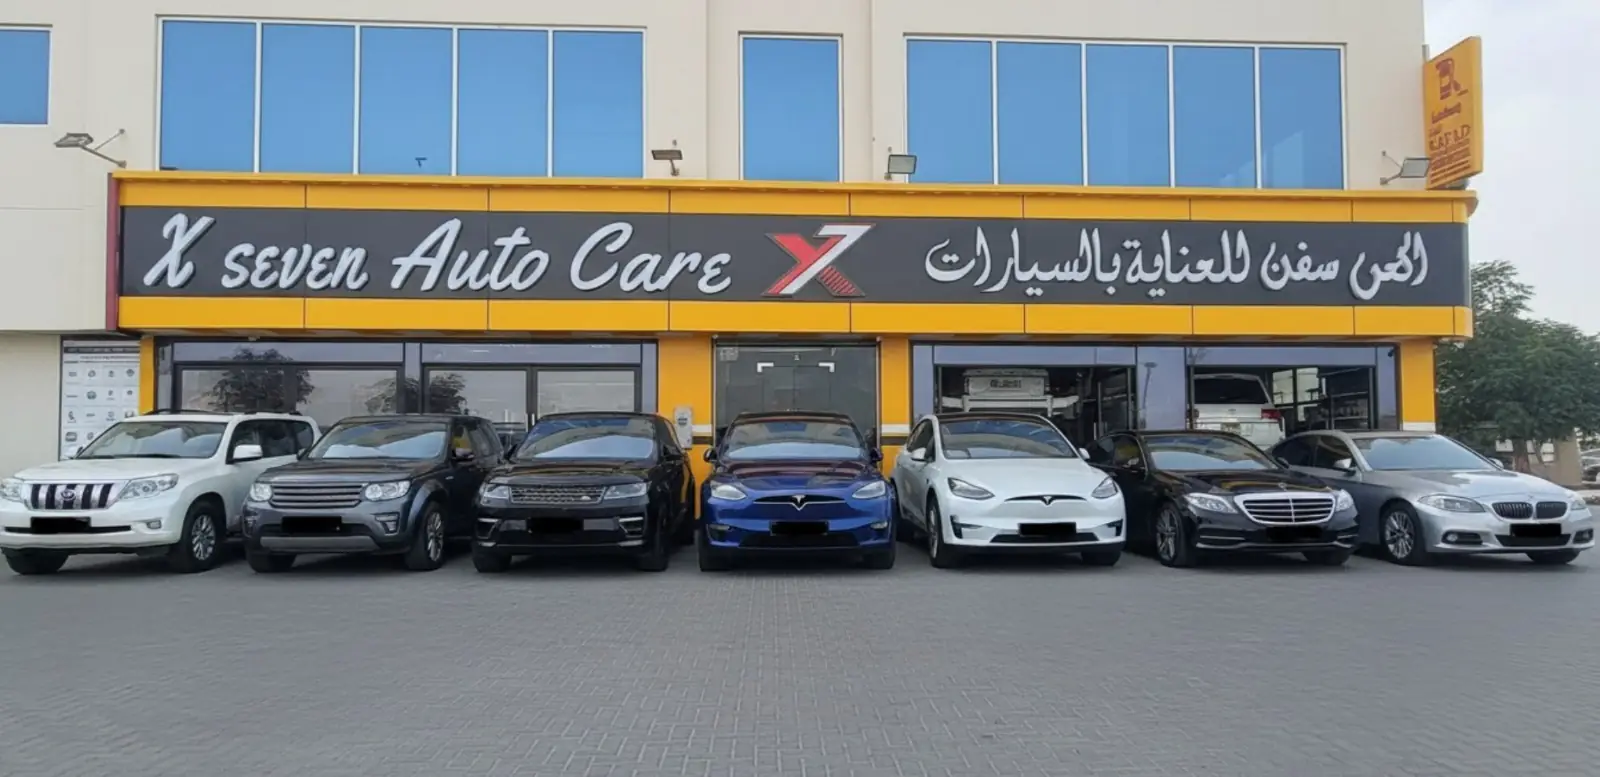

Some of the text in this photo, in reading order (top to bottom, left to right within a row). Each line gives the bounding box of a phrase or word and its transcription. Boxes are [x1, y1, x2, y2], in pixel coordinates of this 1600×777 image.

[143, 212, 216, 289] X
[390, 217, 550, 292] Auto
[569, 221, 732, 294] Care
[924, 225, 1122, 297] بالسيارات
[1124, 228, 1251, 298] للعناية
[1260, 241, 1340, 291] سفن
